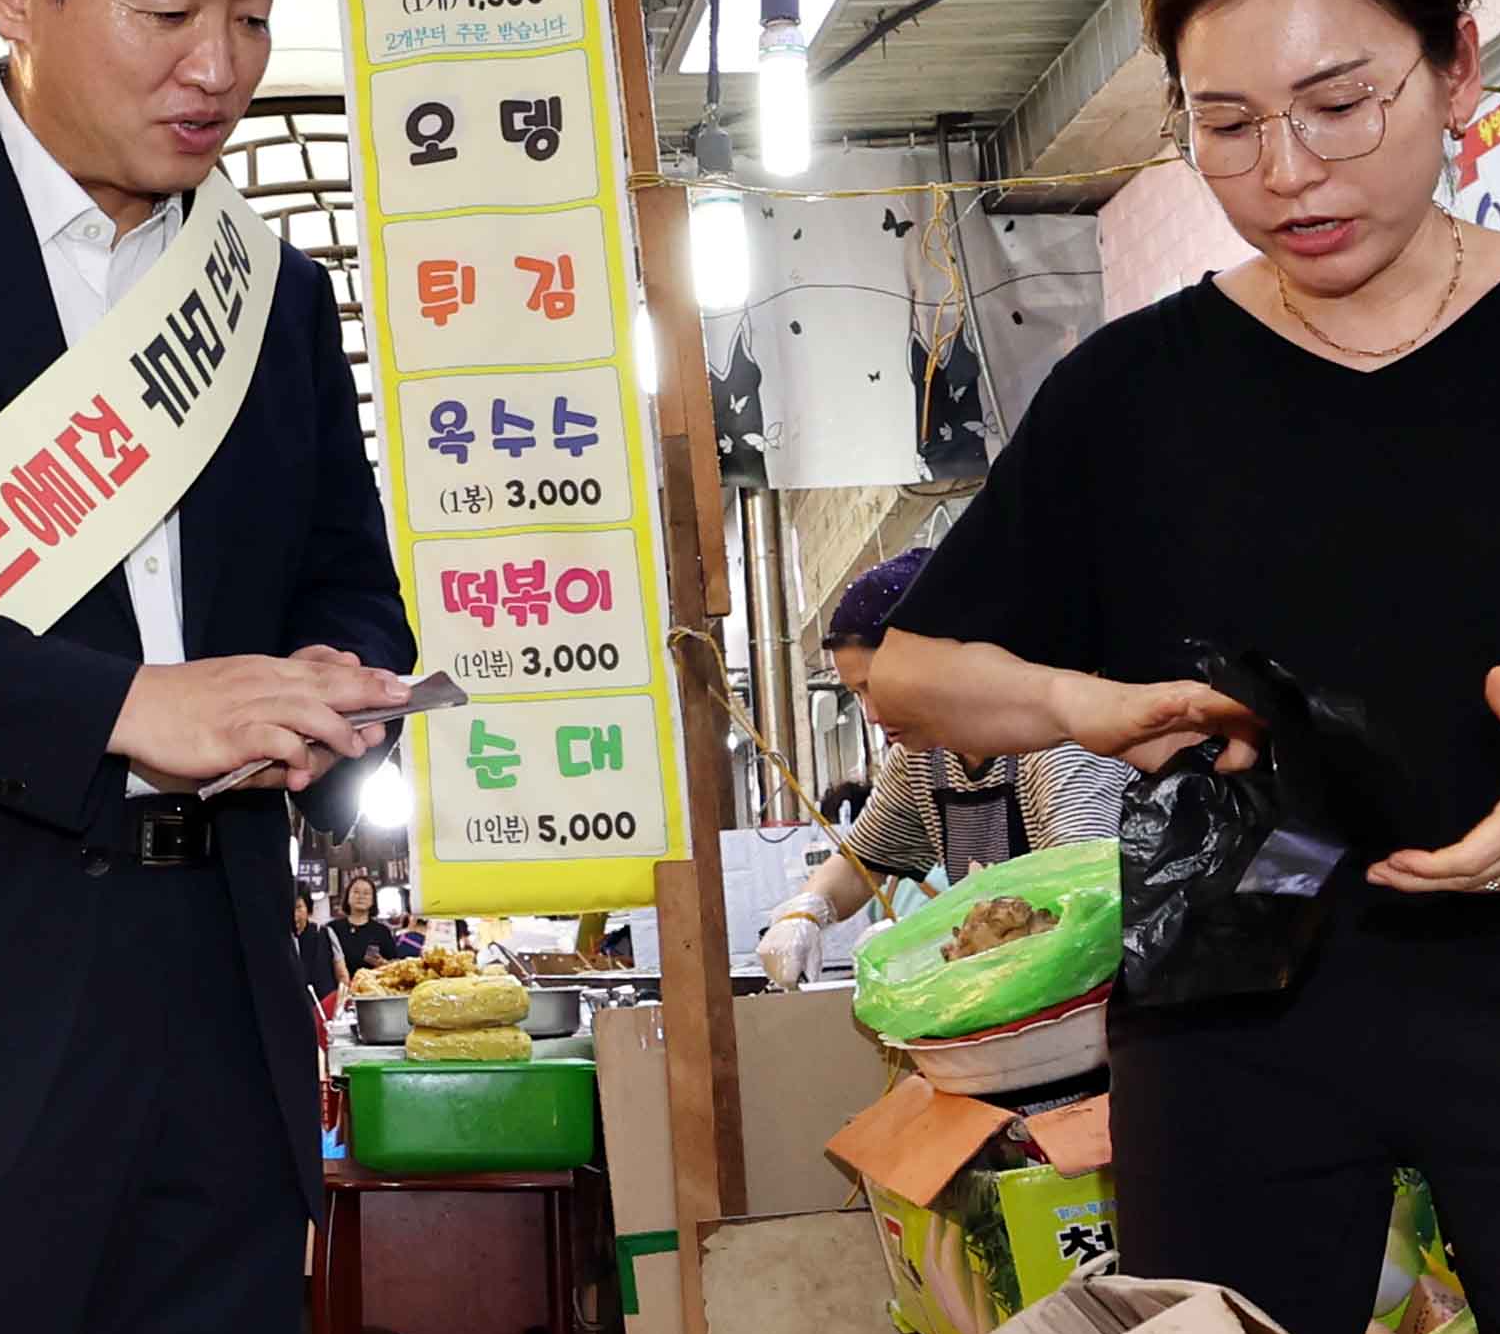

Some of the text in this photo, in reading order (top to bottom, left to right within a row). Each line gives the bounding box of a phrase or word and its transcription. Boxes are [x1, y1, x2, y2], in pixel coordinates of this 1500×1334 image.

[385, 24, 448, 53] 2개부터
[455, 20, 489, 44] 주문
[129, 288, 232, 429] 모두
[428, 395, 600, 465] 옥수수
[439, 478, 602, 516] (1봉) 3,000
[440, 559, 613, 627] 떡볶이
[454, 643, 620, 681] (1인분) 3,000
[466, 810, 637, 845] (1인분) 5,000
